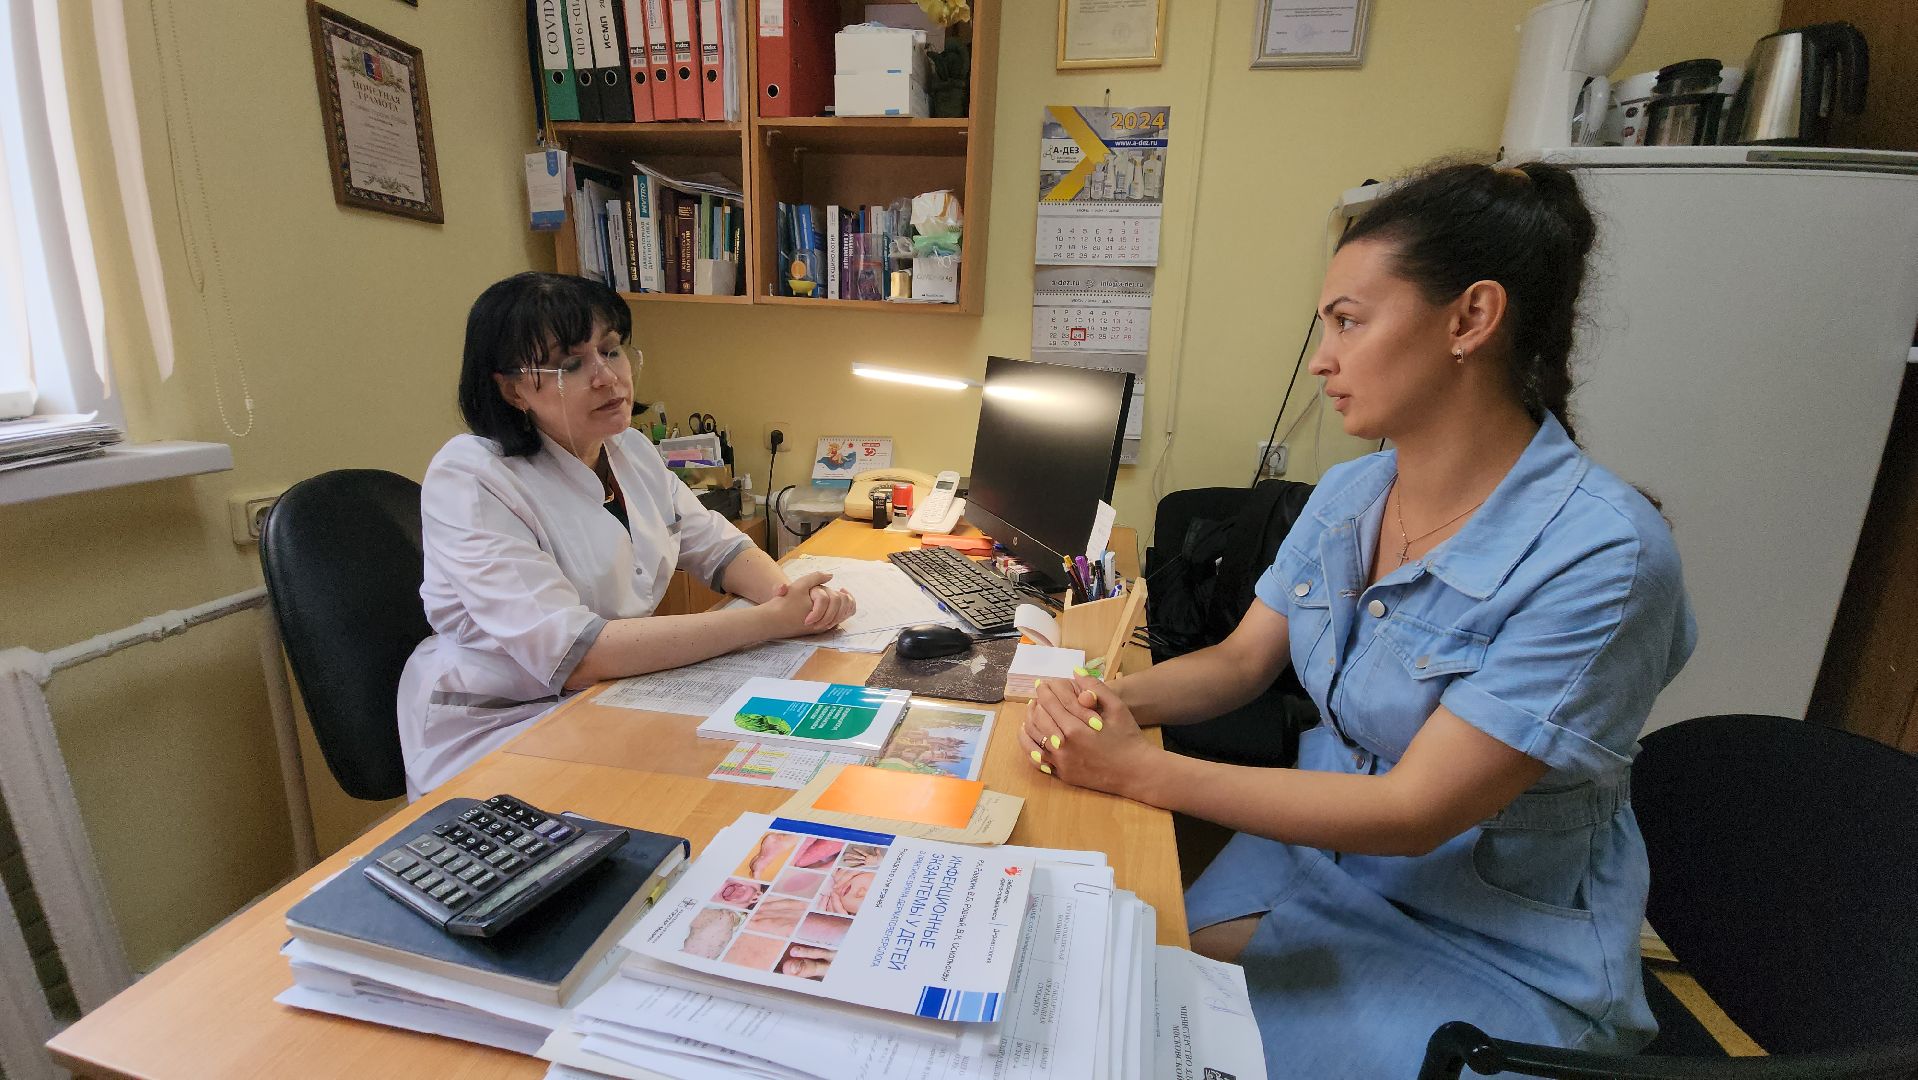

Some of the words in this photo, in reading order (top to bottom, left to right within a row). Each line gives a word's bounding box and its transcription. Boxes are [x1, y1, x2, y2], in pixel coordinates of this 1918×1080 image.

[571, 0, 584, 34] ID-19
[599, 15, 612, 49] ИСМП
[1111, 112, 1165, 130] 2024
[478, 816, 489, 824] 2
[909, 853, 945, 917] ЭКЗАНТЕМЫ
[920, 855, 962, 950] ИНФЕКЦИОННЫЕ
[906, 919, 920, 928] У
[887, 927, 916, 971] ДЕТЕЙ
[1181, 1005, 1192, 1066] МИНИСТЕРСТВО
